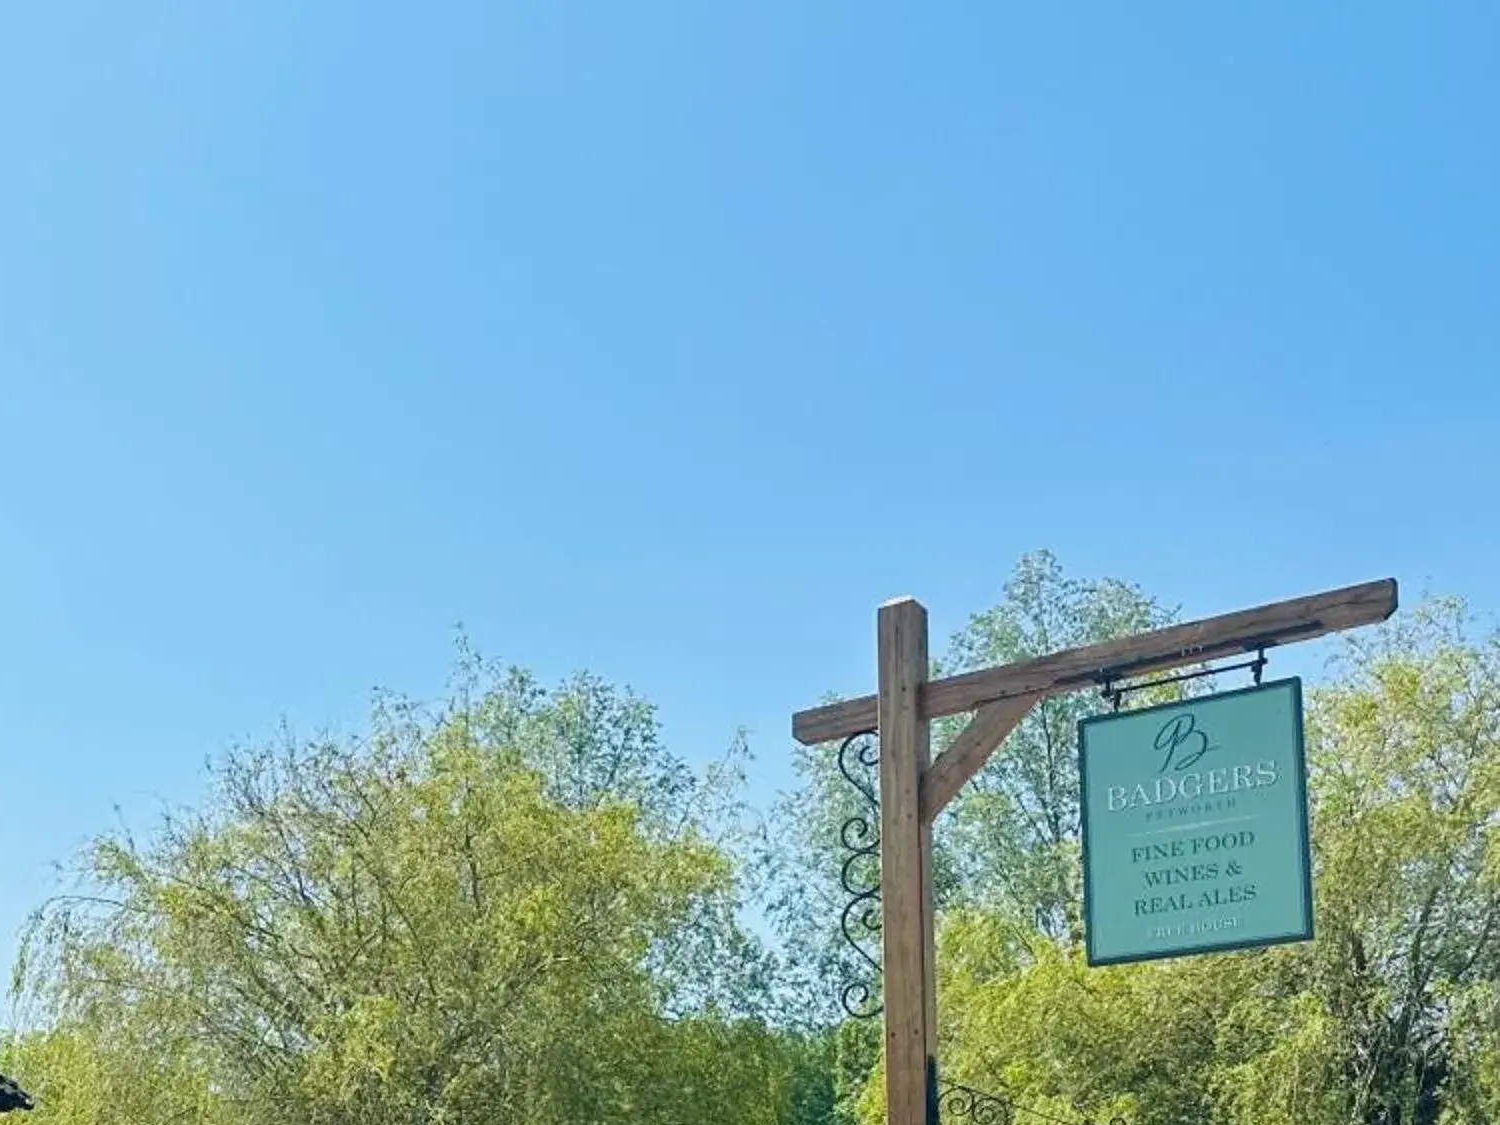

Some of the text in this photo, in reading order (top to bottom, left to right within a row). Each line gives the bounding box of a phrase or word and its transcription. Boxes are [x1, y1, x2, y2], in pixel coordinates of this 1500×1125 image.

[1108, 759, 1281, 811] BADGERS
[1131, 831, 1256, 863] FINE FOOD
[1144, 859, 1243, 889] WINES &
[1133, 884, 1257, 917] REAL ALES
